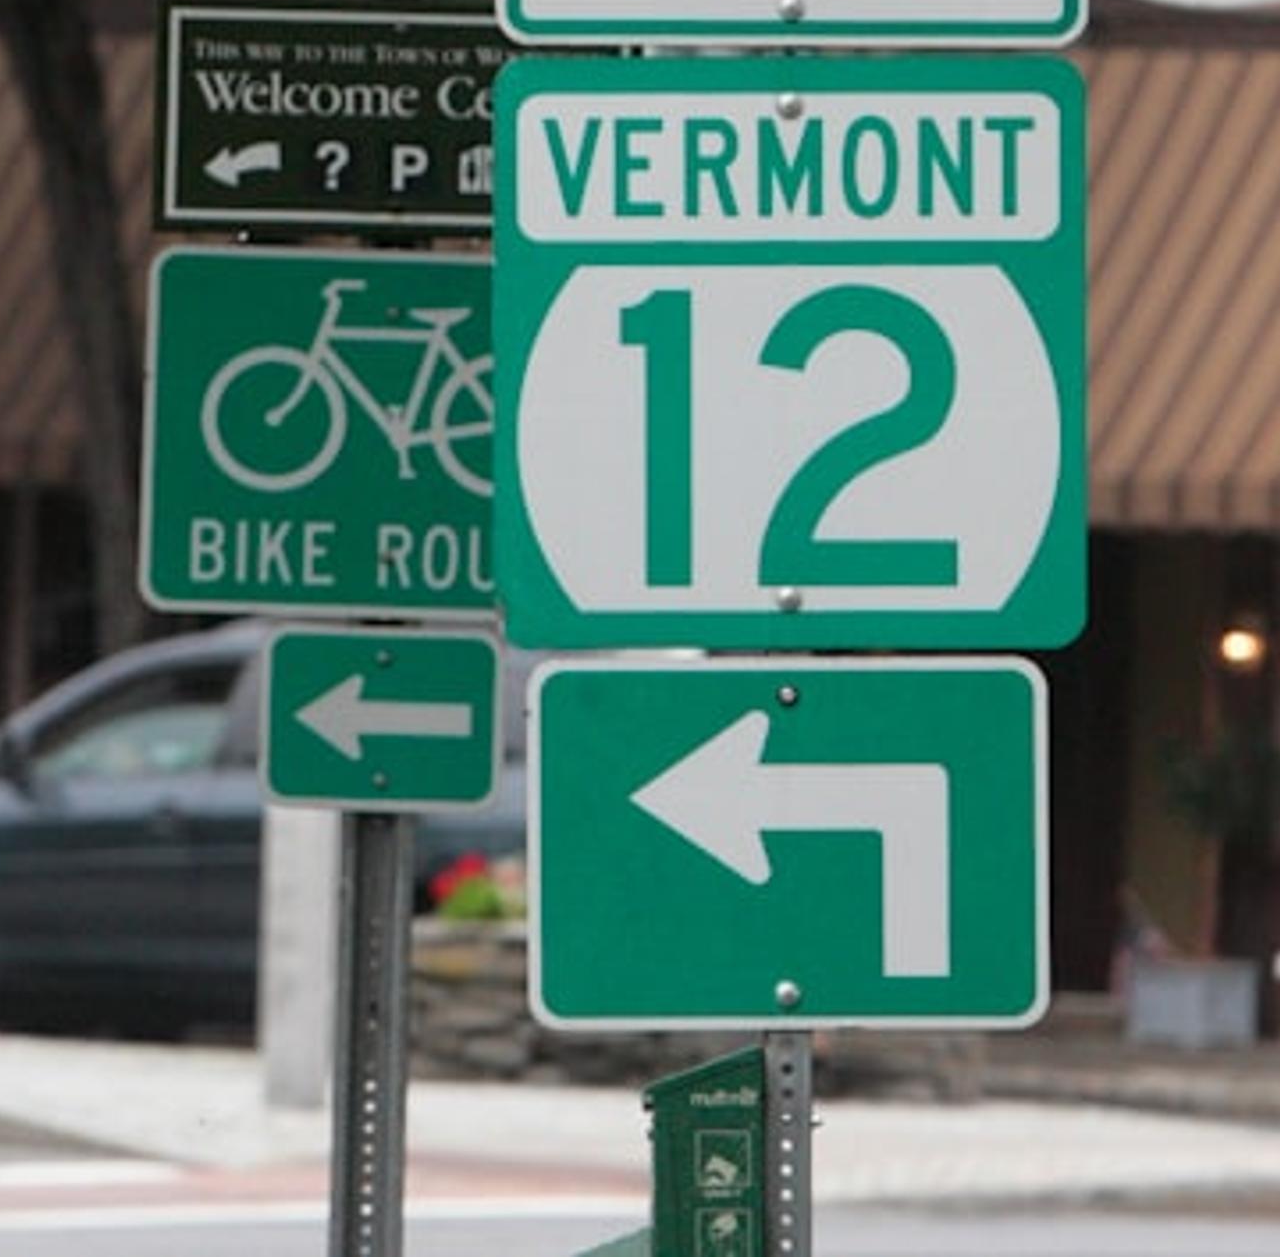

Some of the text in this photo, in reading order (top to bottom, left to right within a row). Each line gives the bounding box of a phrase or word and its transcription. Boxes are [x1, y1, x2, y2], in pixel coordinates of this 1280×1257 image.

[196, 68, 420, 117] Welcome
[542, 114, 1036, 220] VERMONT
[618, 283, 960, 589] 12
[189, 518, 335, 585] BIKE
